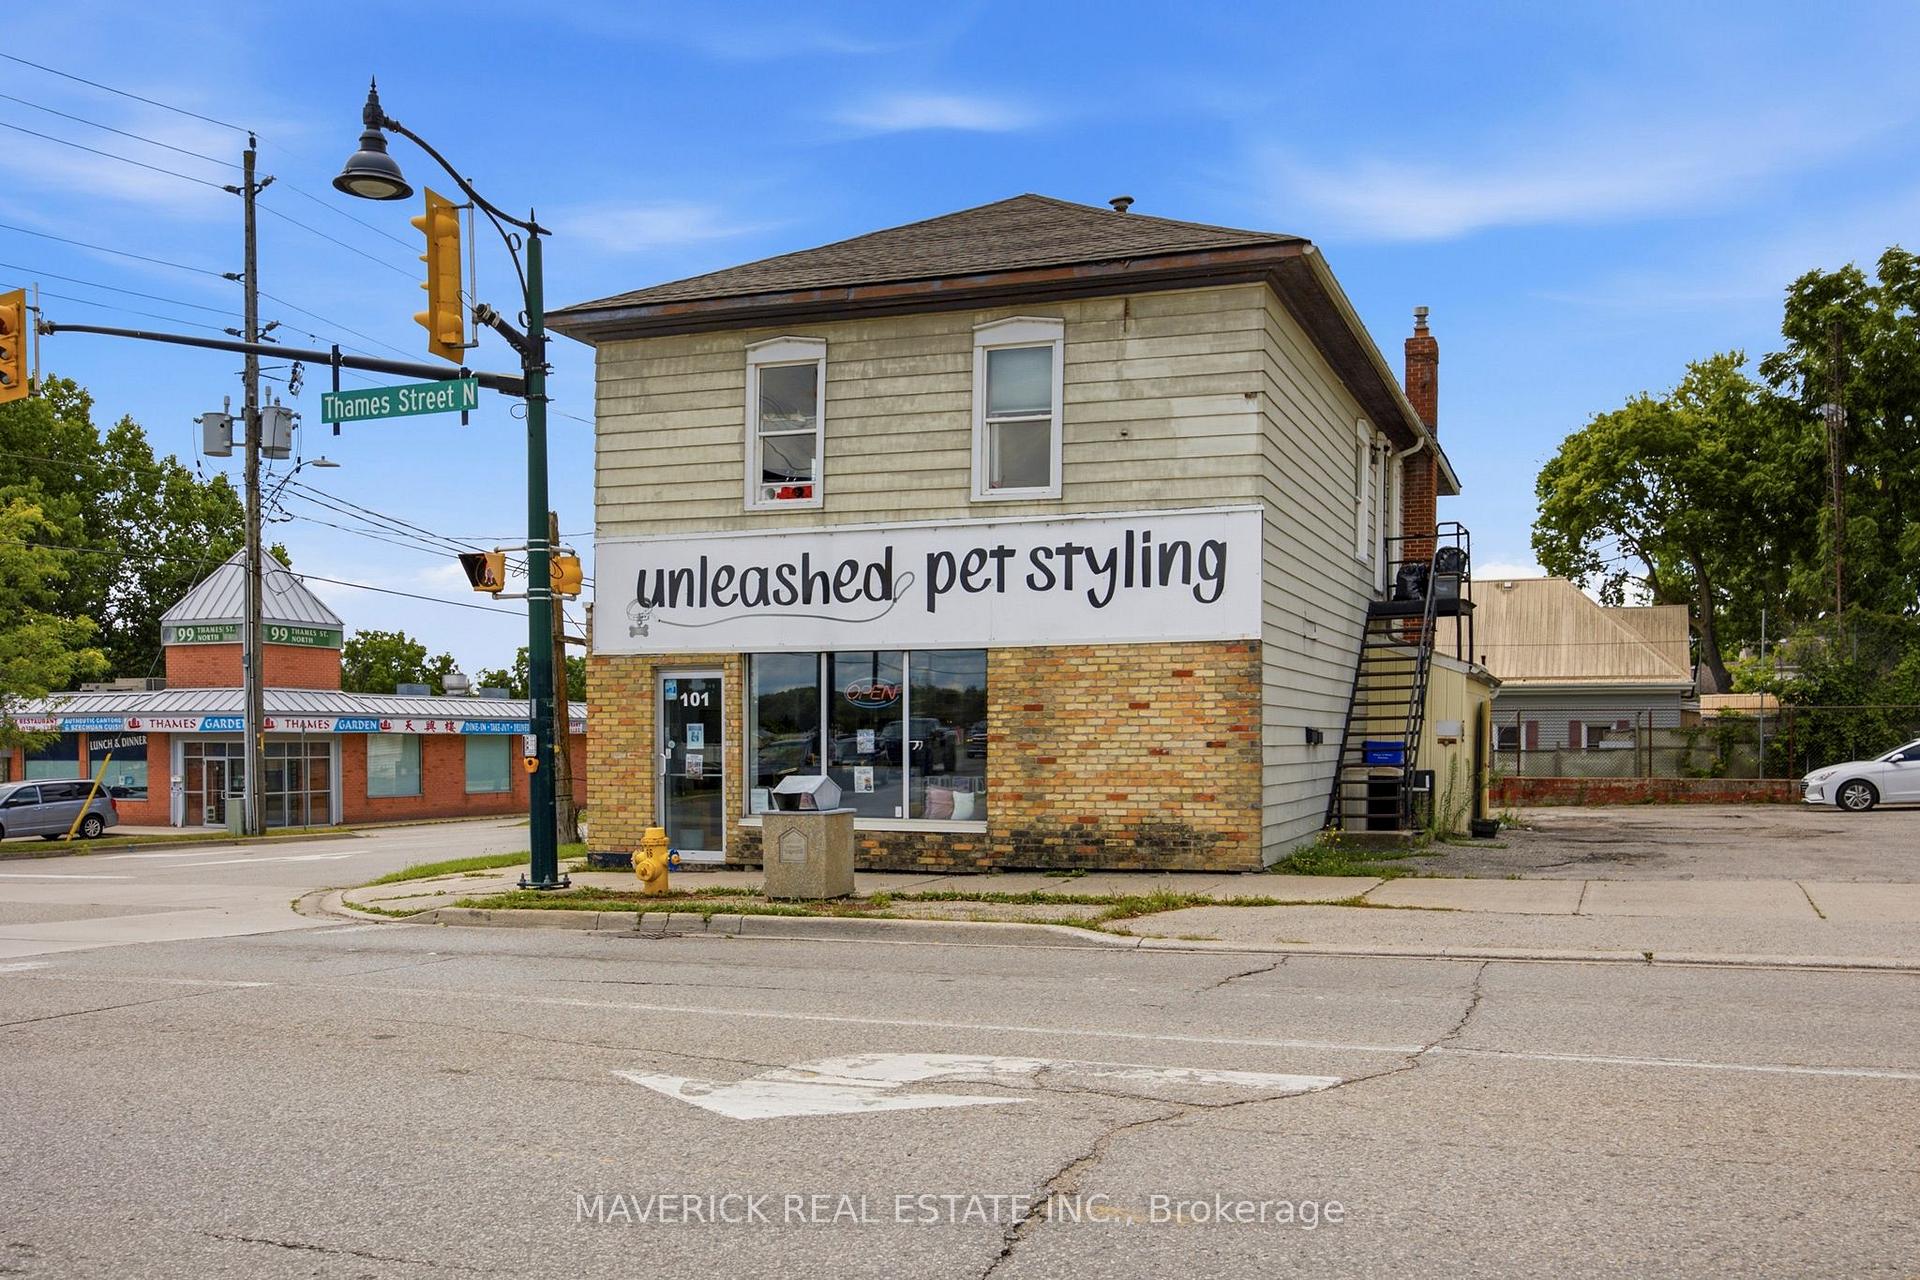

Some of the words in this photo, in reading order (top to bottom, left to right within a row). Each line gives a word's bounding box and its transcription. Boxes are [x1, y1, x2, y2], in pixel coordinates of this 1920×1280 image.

[324, 395, 390, 419] Thames
[399, 385, 454, 412] Street
[463, 382, 475, 406] N
[638, 546, 893, 609] unleashed
[928, 544, 1016, 612] pet
[1026, 530, 1227, 609] styling
[178, 627, 194, 642] 99
[225, 625, 235, 633] ST.
[271, 626, 288, 641] 99
[291, 628, 317, 636] THAMES
[291, 636, 314, 644] NORTH
[680, 691, 709, 707] 101
[846, 684, 900, 700] OPEN
[149, 719, 197, 729] THAMES
[284, 719, 330, 730] THAMES
[339, 719, 378, 730] GARDEN
[90, 739, 113, 751] LUNCH
[114, 738, 121, 748] &
[121, 735, 148, 748] DINNER
